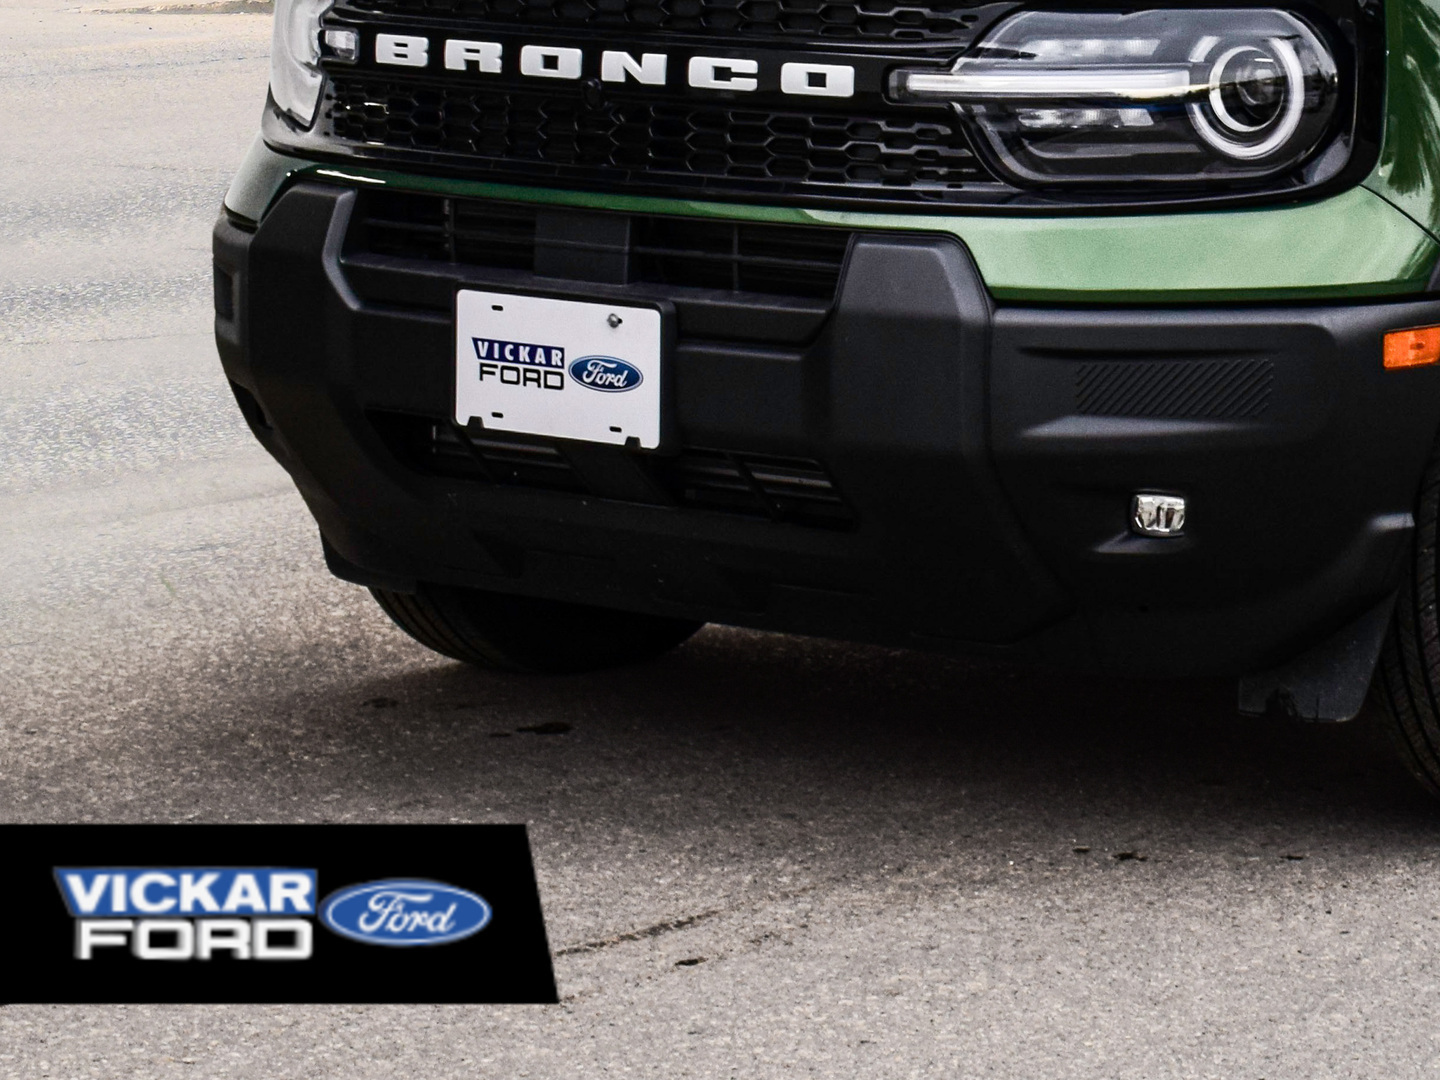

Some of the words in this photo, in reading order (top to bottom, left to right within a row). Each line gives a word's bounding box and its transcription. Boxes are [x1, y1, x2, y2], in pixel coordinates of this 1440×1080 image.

[375, 33, 855, 98] BRONCO
[477, 340, 563, 367] VICKAR
[479, 363, 565, 391] FORD
[582, 359, 628, 388] Ford
